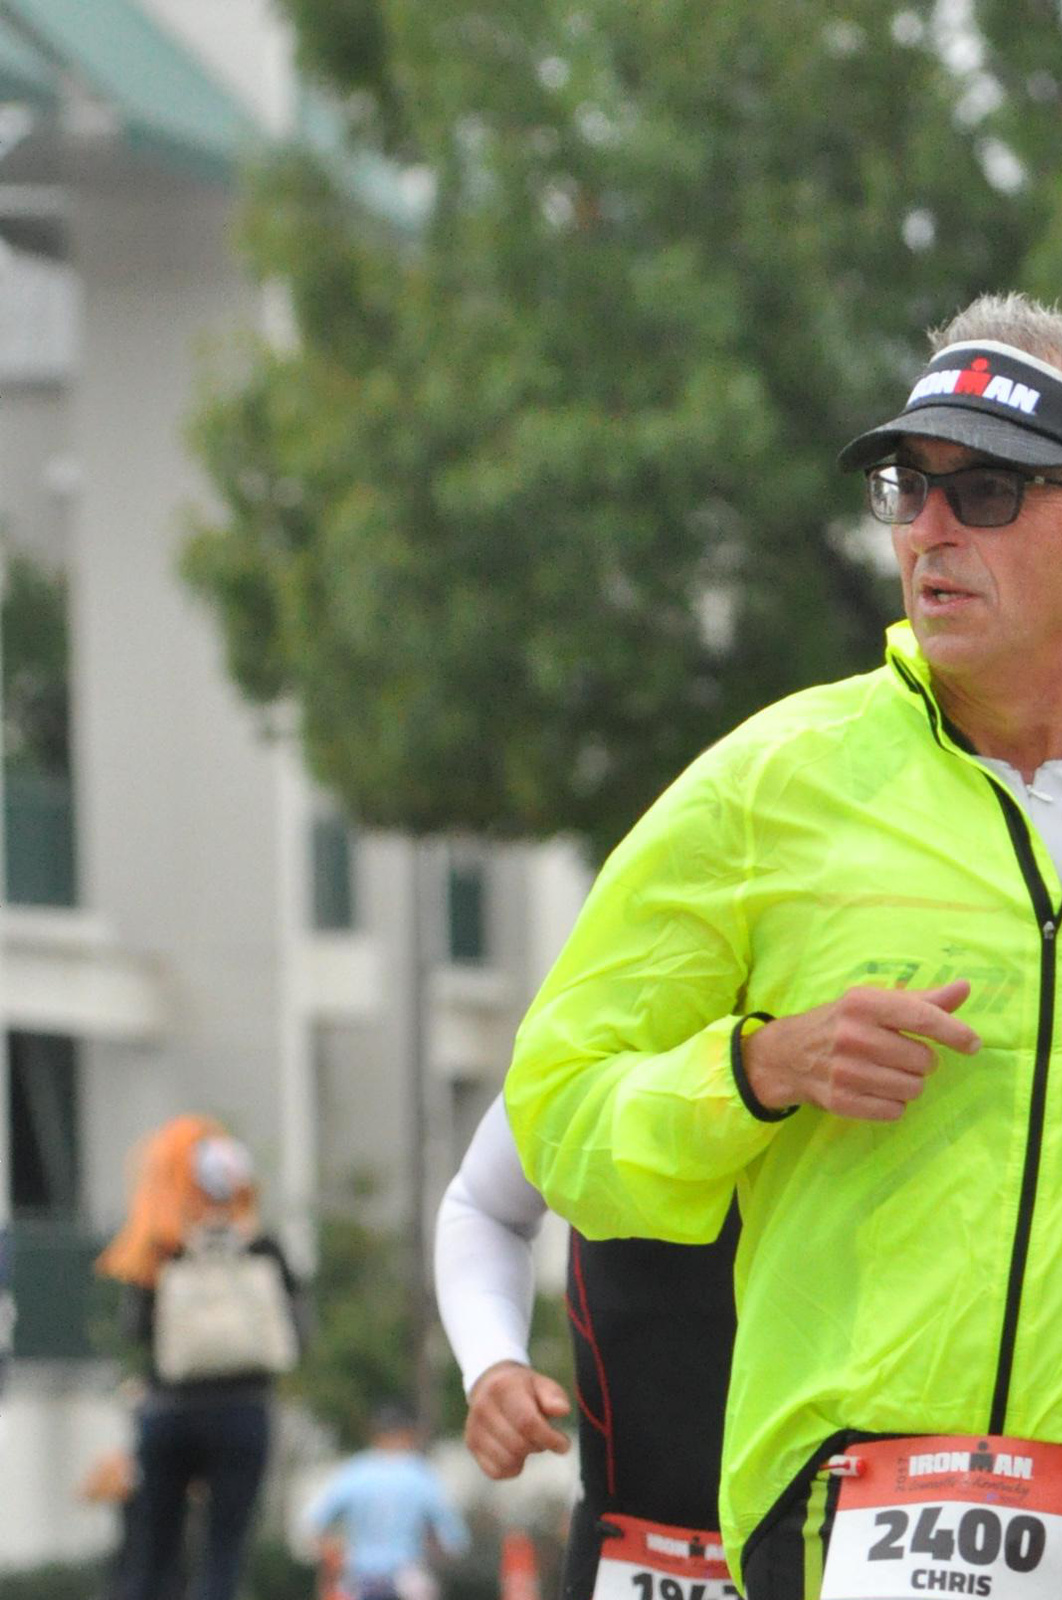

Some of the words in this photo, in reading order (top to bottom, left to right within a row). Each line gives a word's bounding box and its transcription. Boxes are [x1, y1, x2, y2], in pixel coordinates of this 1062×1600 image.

[908, 1441, 1034, 1480] IRONMAN
[867, 1507, 1046, 1573] 2400
[911, 1569, 992, 1597] CHRIS
